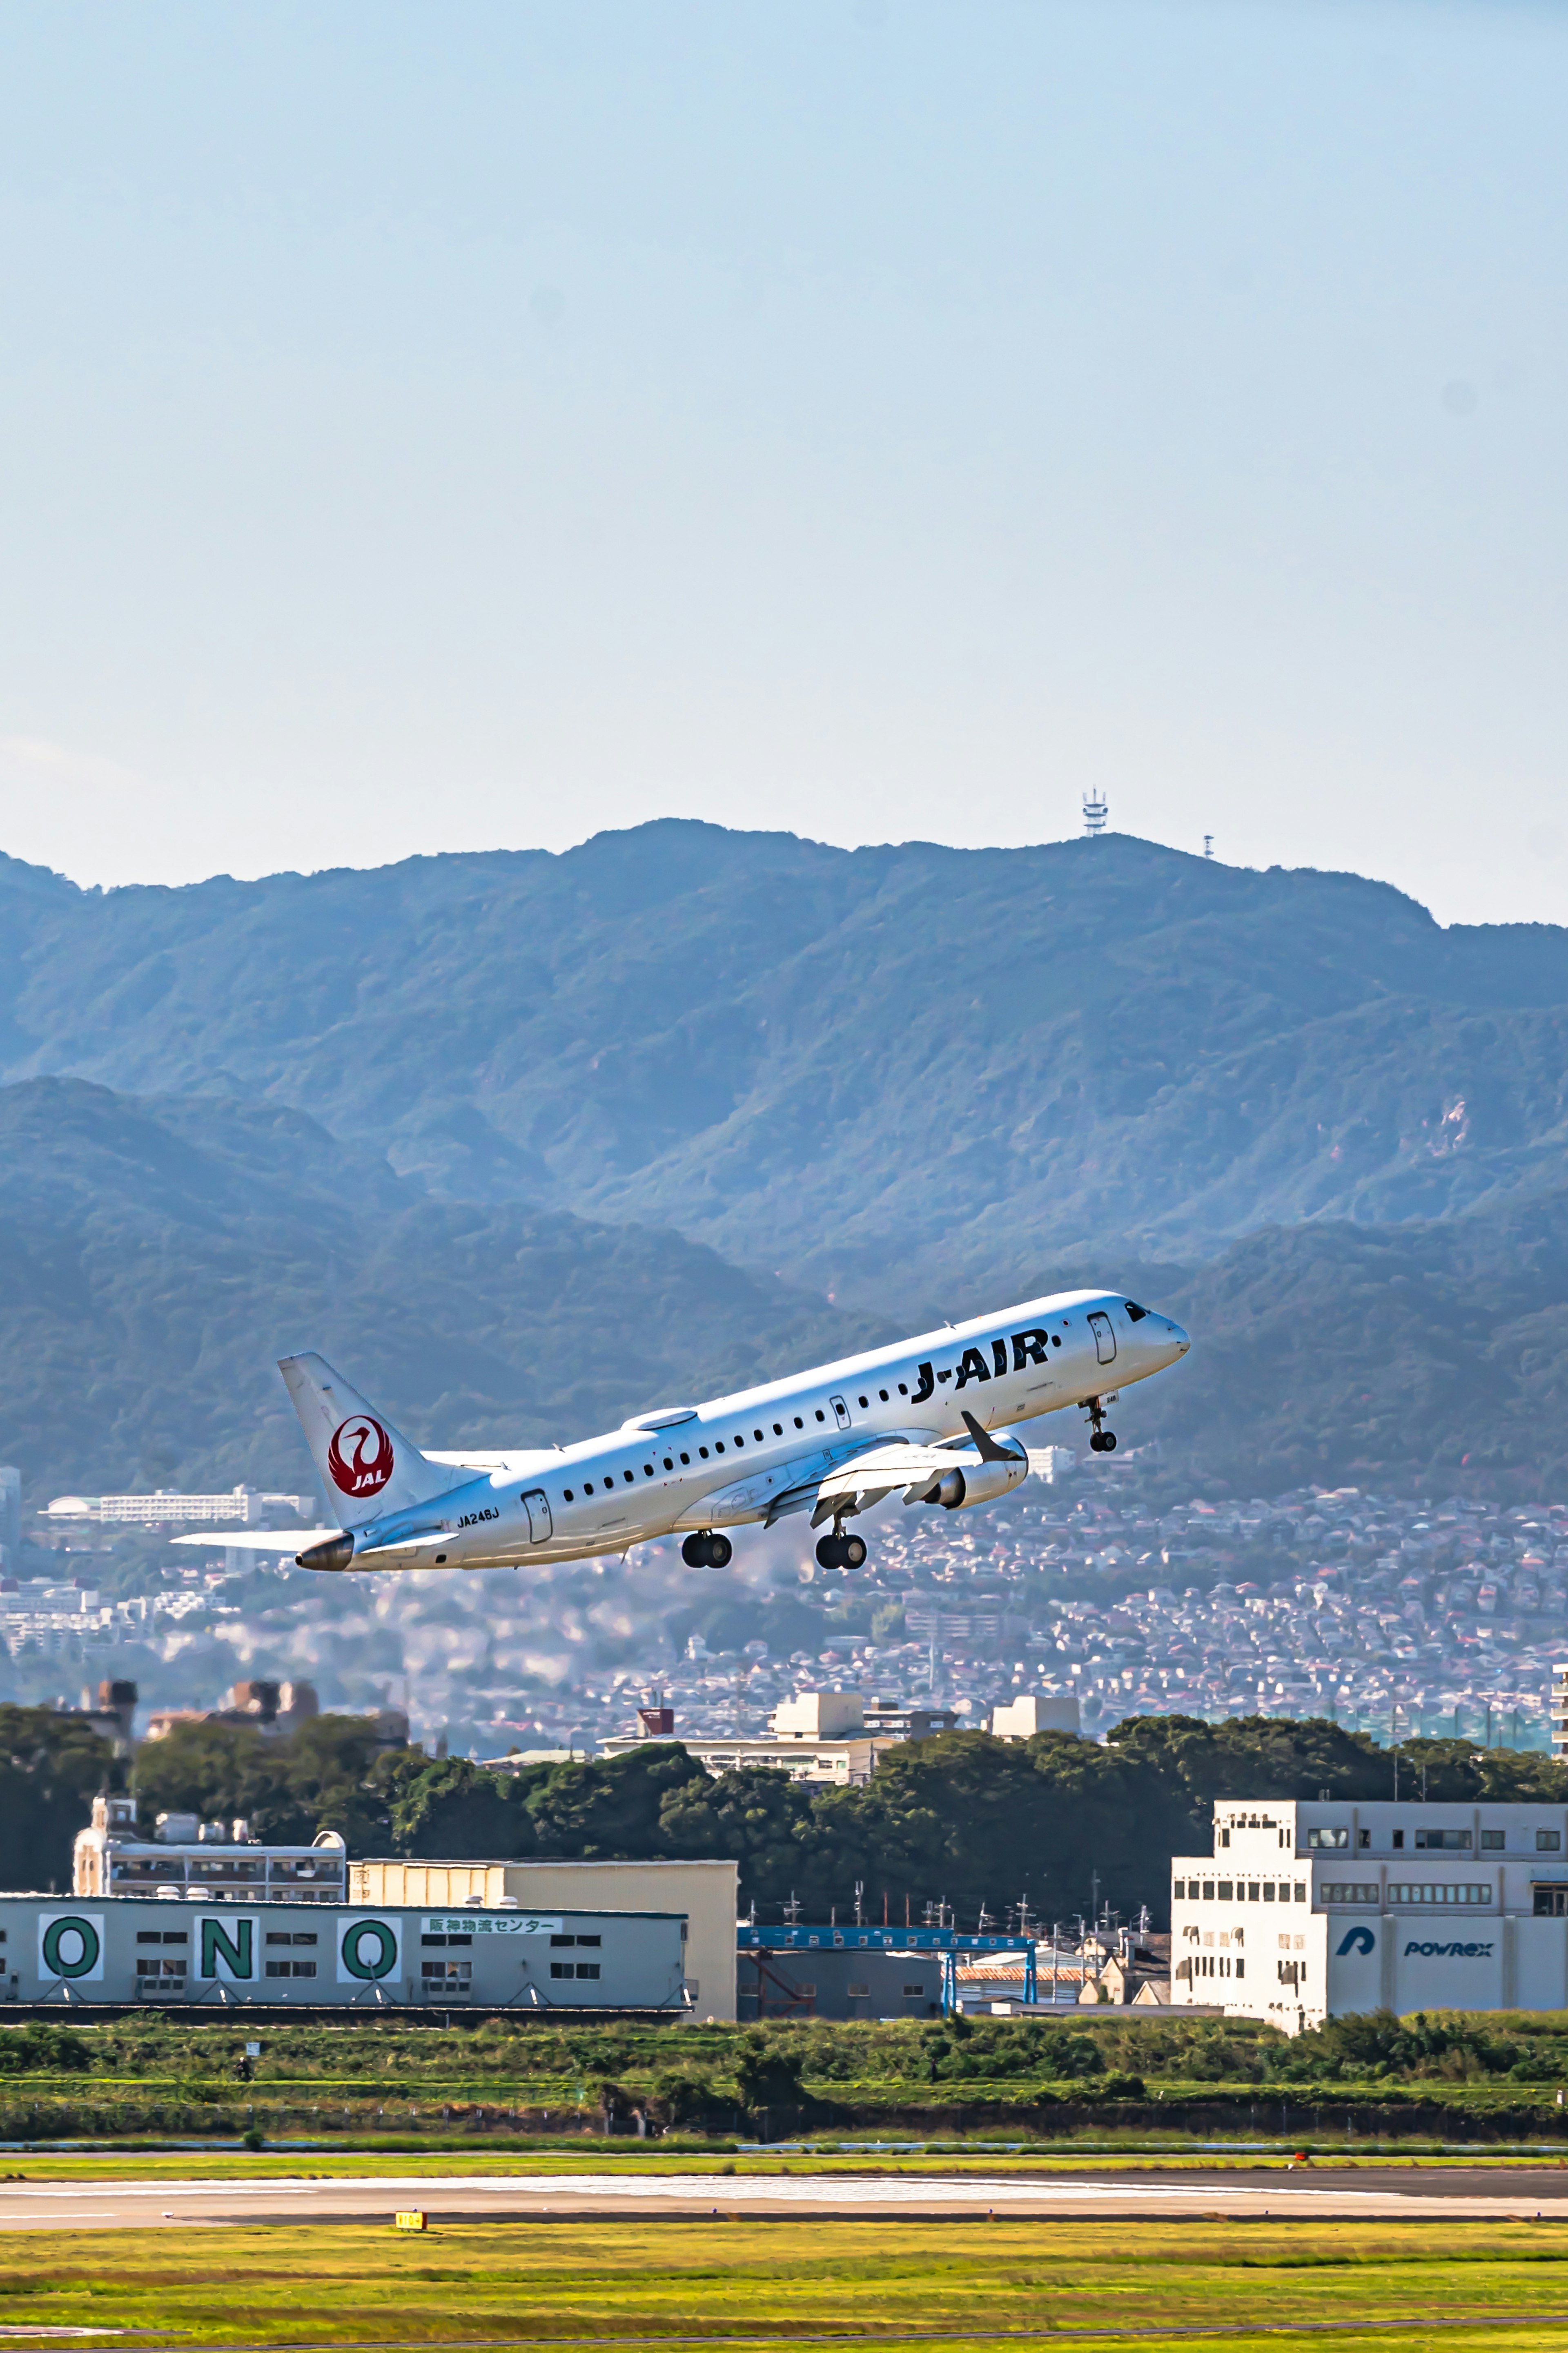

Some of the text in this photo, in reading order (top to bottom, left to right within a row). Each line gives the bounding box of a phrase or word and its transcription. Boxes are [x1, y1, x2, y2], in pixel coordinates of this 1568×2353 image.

[911, 1329, 1048, 1404] J-AIR
[352, 1470, 386, 1491] JAL
[429, 1918, 554, 1933] 阪神物流センター
